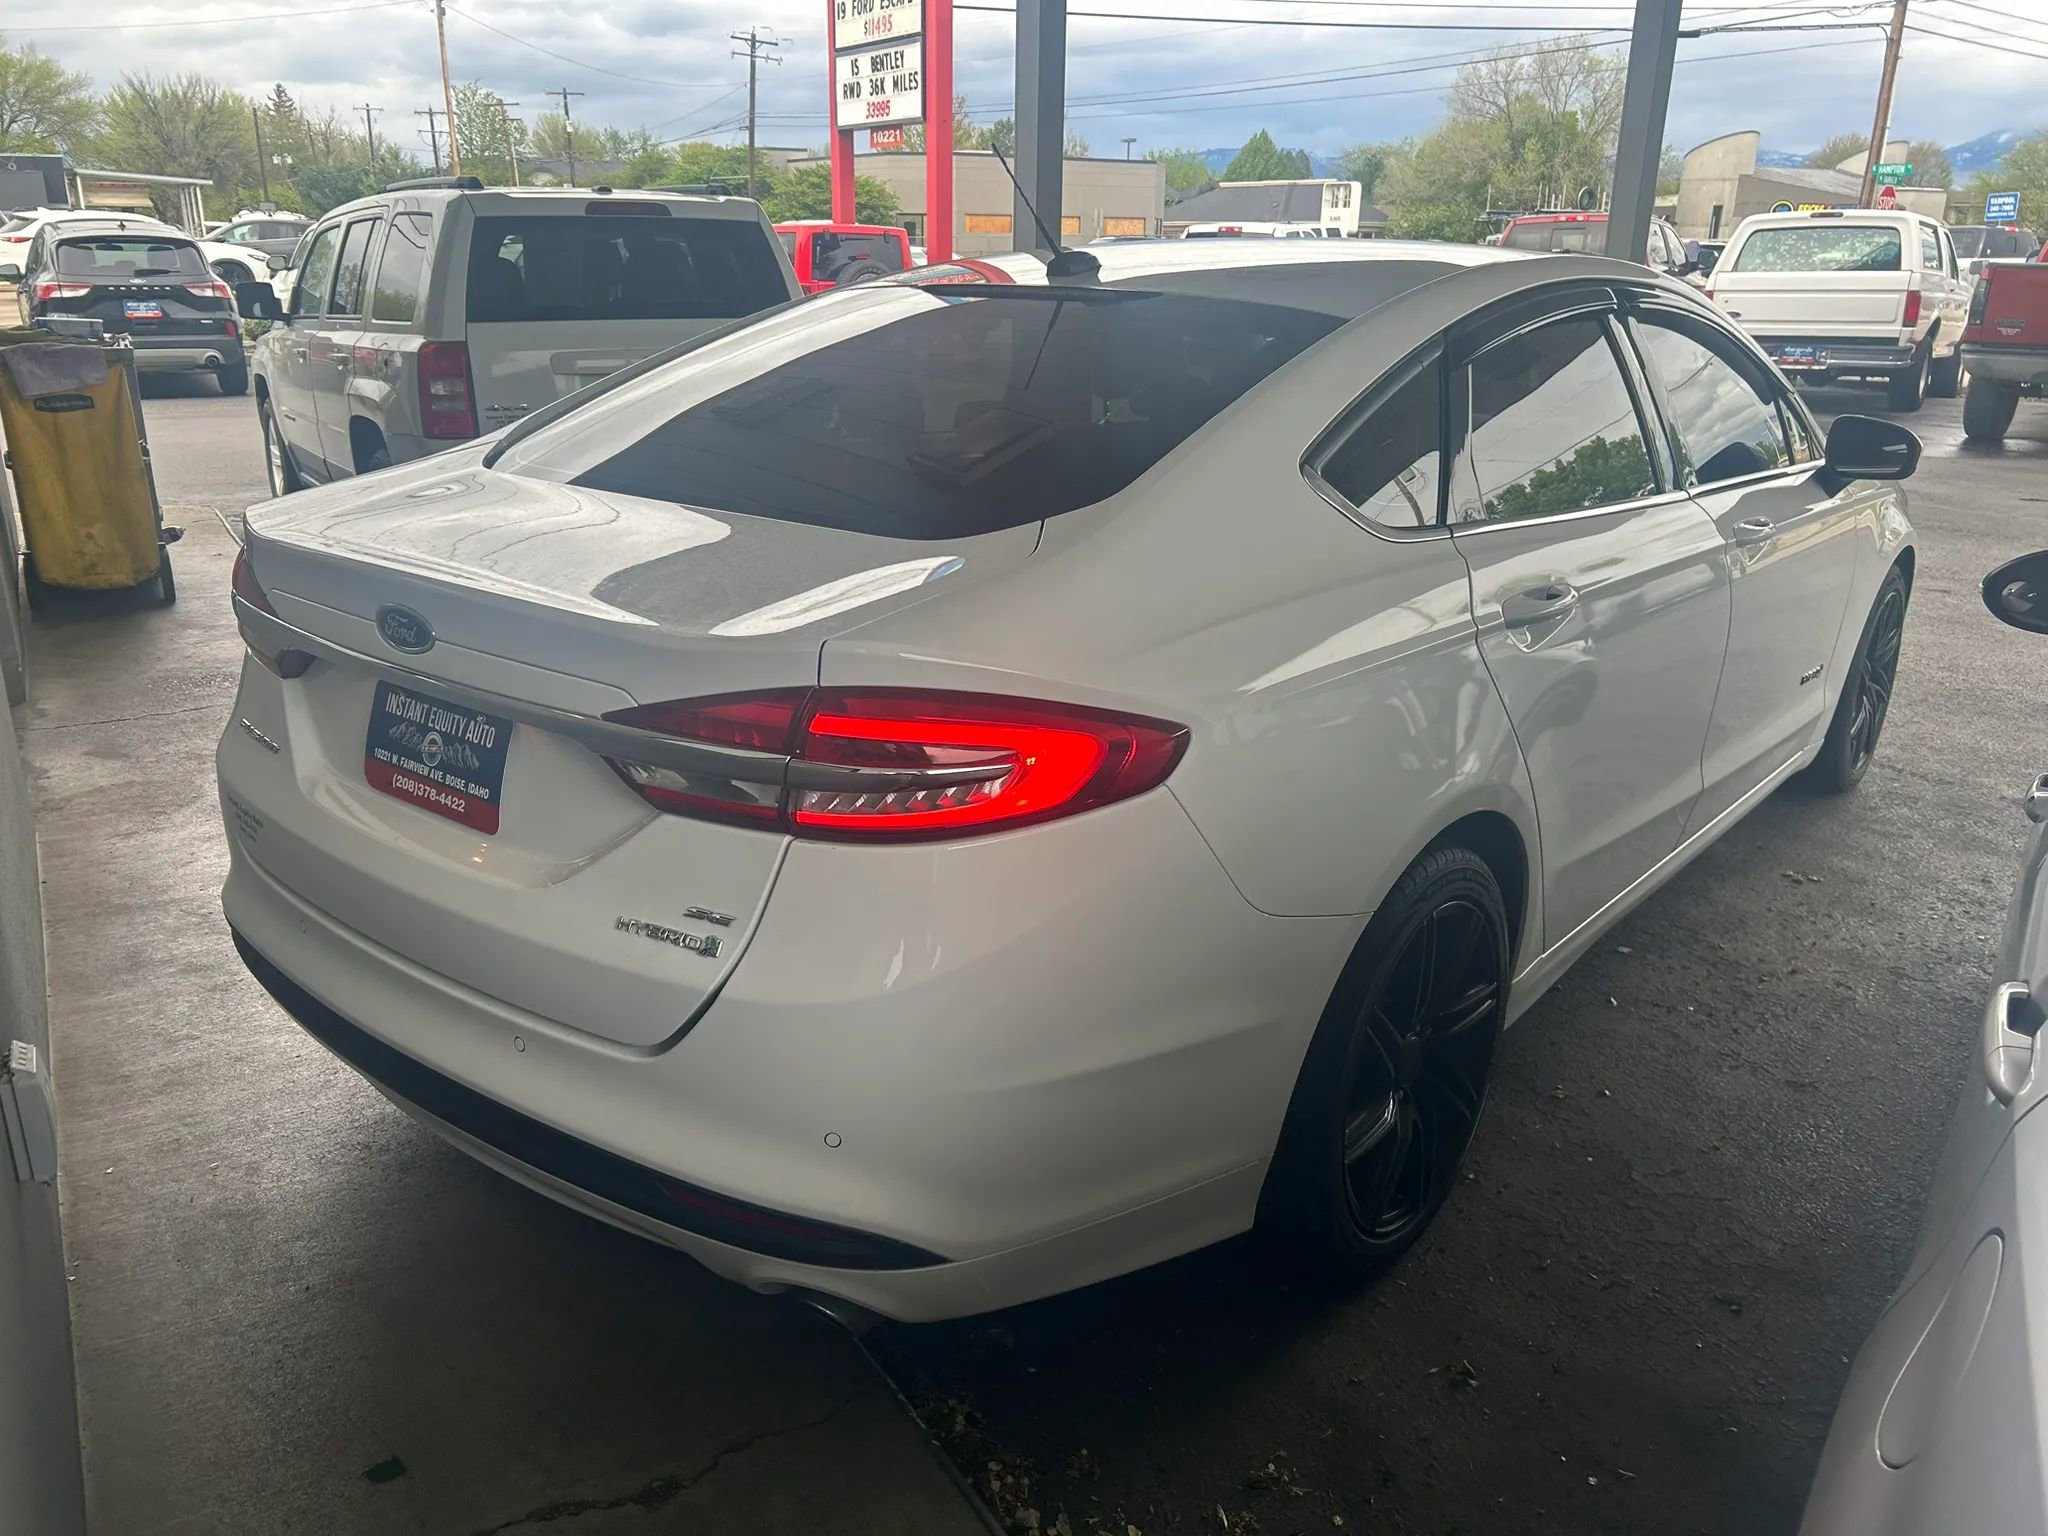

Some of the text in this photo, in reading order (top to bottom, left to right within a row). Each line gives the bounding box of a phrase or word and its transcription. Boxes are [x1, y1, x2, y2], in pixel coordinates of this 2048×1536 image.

[837, 1, 846, 20] 19
[852, 0, 874, 17] FORD
[864, 14, 893, 37] $11495
[870, 50, 905, 73] BENTLEY
[843, 71, 919, 100] RWD 36K MILES
[865, 100, 891, 119] 33995
[871, 129, 901, 144] 10221
[1878, 195, 1896, 210] STOP
[386, 613, 416, 643] Ford
[385, 692, 495, 748] INSTANT EQUITY AUTO
[374, 747, 391, 762] 10221
[391, 755, 399, 766] W.
[400, 757, 429, 777] FAIRVIEW
[445, 773, 466, 793] BOISE,
[467, 782, 490, 800] IDAHO
[392, 773, 465, 812] (208)378-4422
